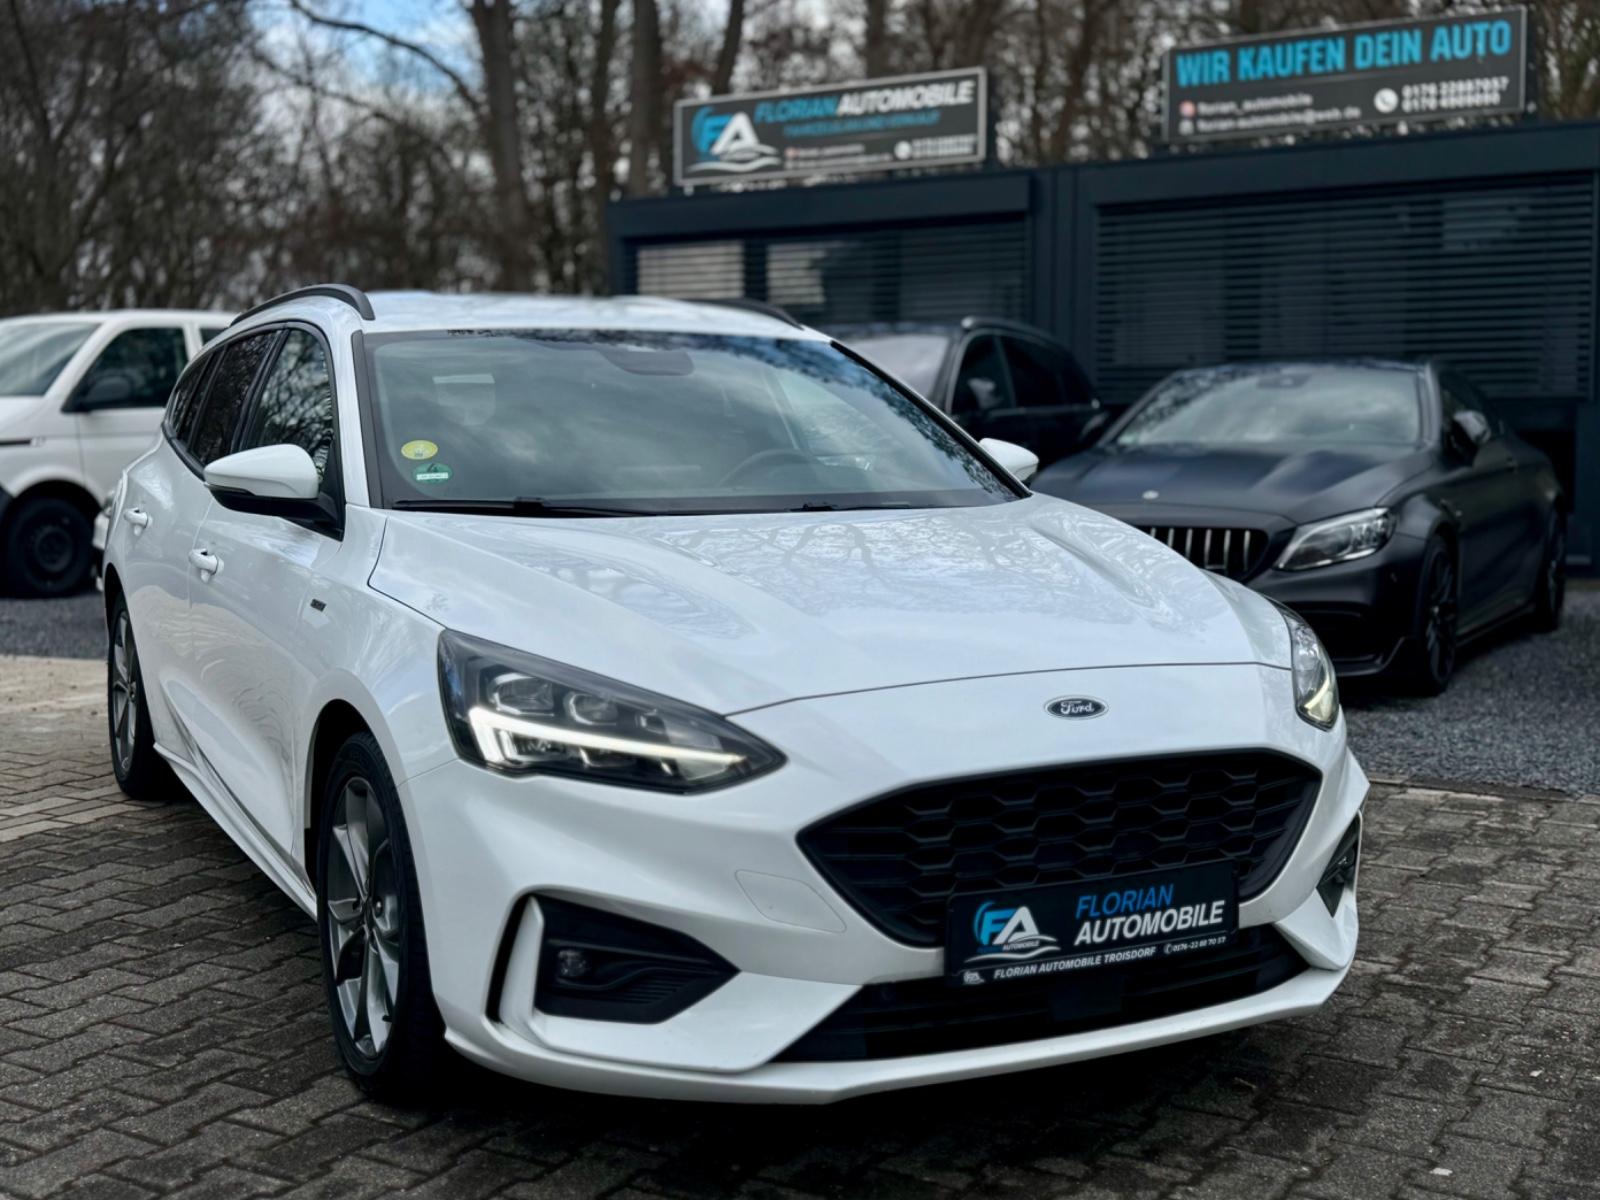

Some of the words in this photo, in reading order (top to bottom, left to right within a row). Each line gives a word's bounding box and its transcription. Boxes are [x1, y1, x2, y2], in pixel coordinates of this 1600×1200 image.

[1176, 49, 1230, 87] WIR
[1237, 37, 1345, 81] KAUFEN
[1353, 29, 1422, 70] DEIN
[1430, 19, 1512, 60] AUTO
[1060, 700, 1095, 715] Ford
[1075, 884, 1175, 919] FLORIAN
[1073, 900, 1226, 946] AUTOMOBILE
[994, 963, 1038, 980] FLORIAN
[1039, 955, 1102, 973] AUTOMOBILE
[1104, 946, 1157, 963] TROISDORF
